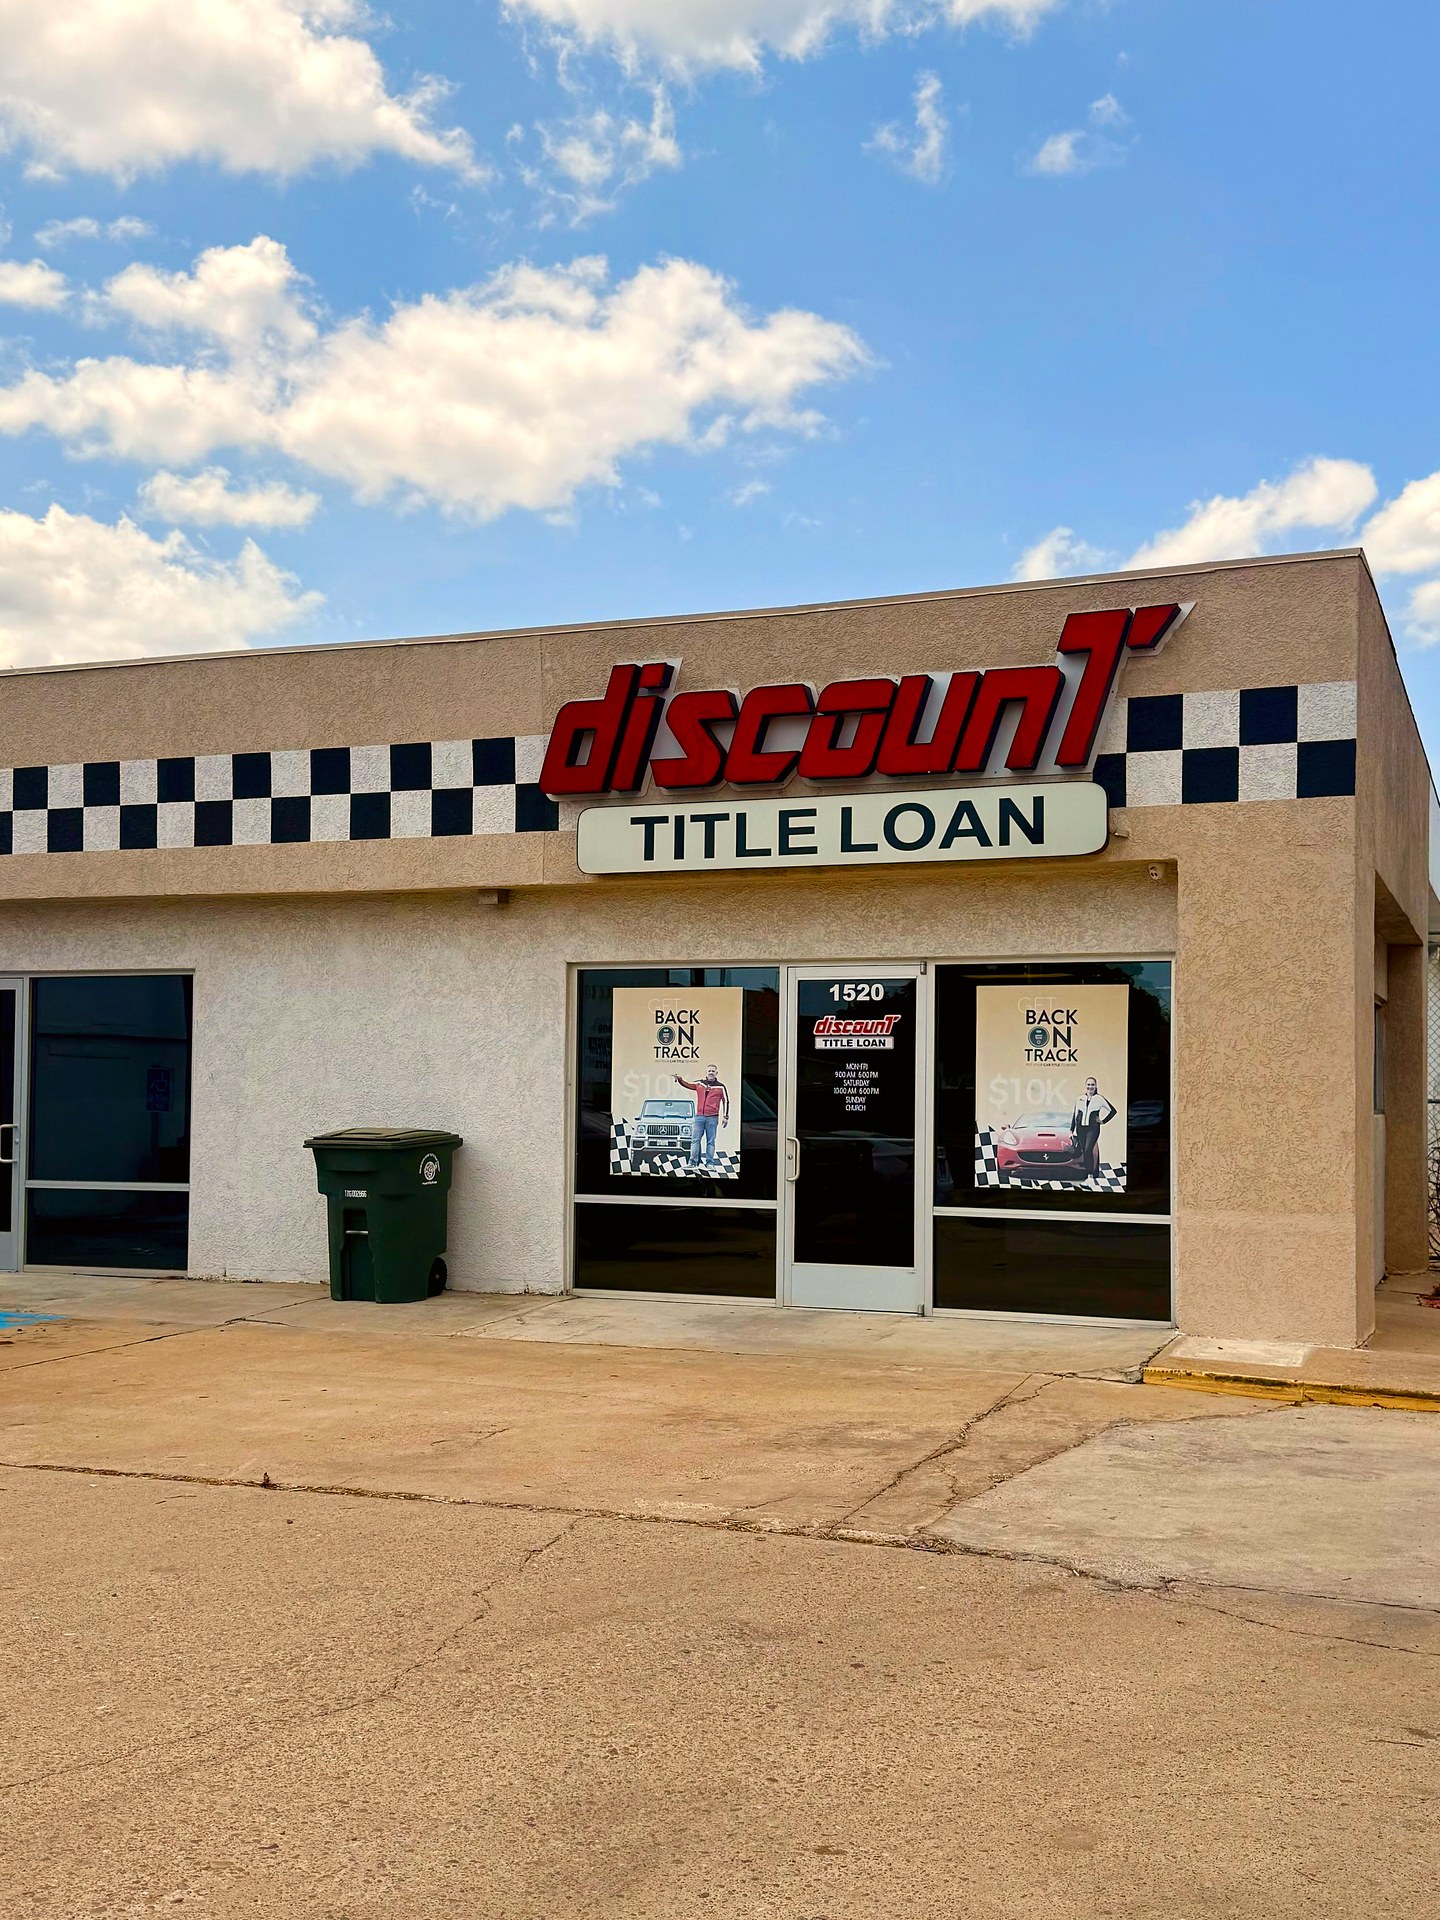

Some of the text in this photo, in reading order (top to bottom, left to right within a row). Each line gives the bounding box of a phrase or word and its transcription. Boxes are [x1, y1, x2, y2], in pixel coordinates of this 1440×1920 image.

[630, 795, 1045, 862] TITLE LOAN
[829, 984, 885, 1001] 1520
[655, 1009, 700, 1024] BACK
[1025, 1009, 1078, 1024] BACK
[822, 1039, 886, 1047] TITLE LOAN
[653, 1046, 700, 1058] TRACK
[1024, 1049, 1078, 1061] TRACK
[846, 1071, 856, 1079] AM
[870, 1071, 879, 1079] PM
[843, 1079, 870, 1087] SATURDAY
[847, 1087, 857, 1095] AM
[871, 1087, 880, 1095] PM
[988, 1072, 1069, 1110] $10K
[845, 1096, 867, 1104] SUNDAY
[845, 1104, 867, 1112] CHURCH
